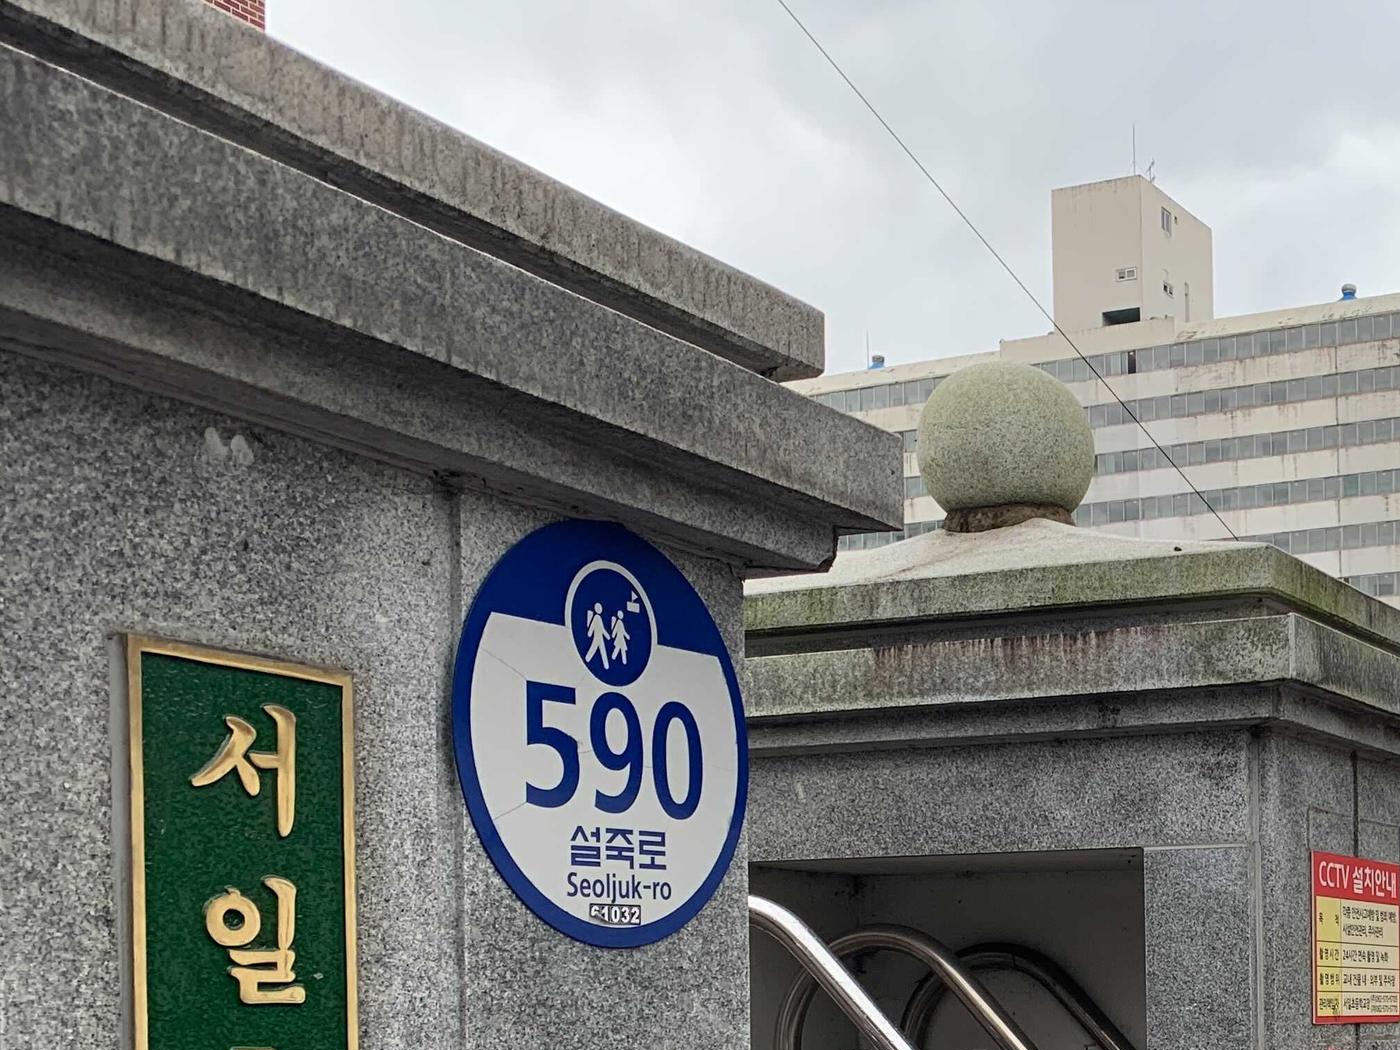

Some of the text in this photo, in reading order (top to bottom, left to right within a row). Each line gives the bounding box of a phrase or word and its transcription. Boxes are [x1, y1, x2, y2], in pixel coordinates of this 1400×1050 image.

[524, 680, 703, 820] 590
[570, 824, 667, 870] 설죽로
[567, 872, 672, 904] Seoljuk-ro
[1319, 860, 1397, 899] CCTV 설치안내
